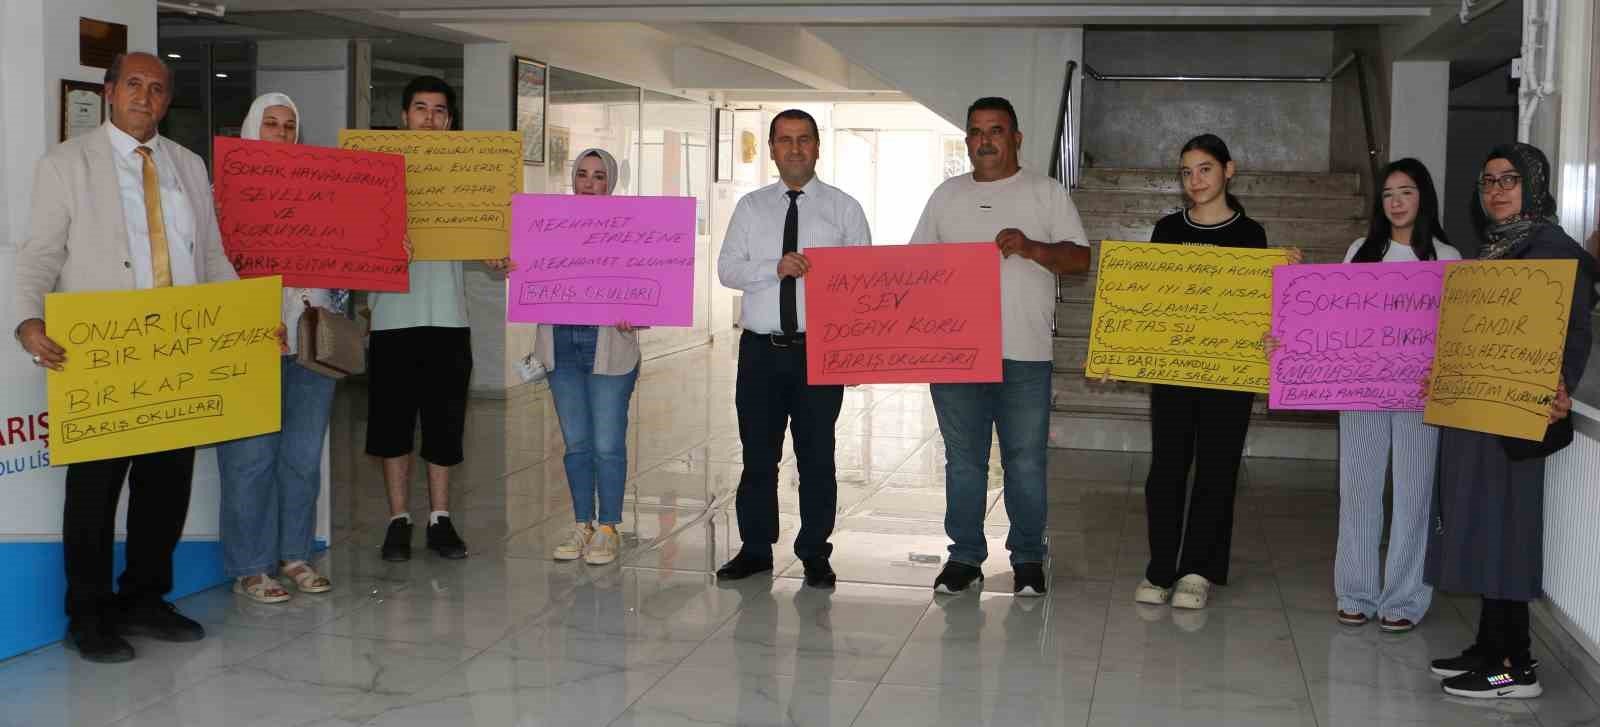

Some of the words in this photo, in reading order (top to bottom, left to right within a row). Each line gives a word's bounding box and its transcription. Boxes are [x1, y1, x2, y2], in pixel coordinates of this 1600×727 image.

[227, 161, 287, 179] SOKAK
[272, 207, 297, 220] VE
[433, 213, 501, 225] KURUMLARI
[527, 215, 634, 233] MERHAMET
[581, 231, 688, 248] ETMEYENE
[526, 256, 622, 273] MERHAMET
[1106, 257, 1184, 273] HAYVANLARA
[826, 268, 957, 293] HAYVANLARI
[1104, 280, 1150, 293] OLAN
[853, 290, 909, 315] SEV
[1293, 289, 1381, 316] SOKAK
[68, 312, 165, 345] ONLAR
[905, 316, 968, 336] KORU
[1171, 323, 1197, 333] SU
[1462, 313, 1529, 336] CANDIR
[153, 336, 203, 359] KAP
[208, 326, 278, 352] YEMEK
[1199, 336, 1230, 347] KAP
[1294, 328, 1376, 355] SUSUZ
[887, 350, 974, 366] OKULLARI
[1231, 364, 1252, 375] VE
[130, 371, 196, 397] KAP
[207, 362, 249, 383] SU
[135, 399, 221, 426] OKULLARI
[0, 411, 49, 448] RIŞ
